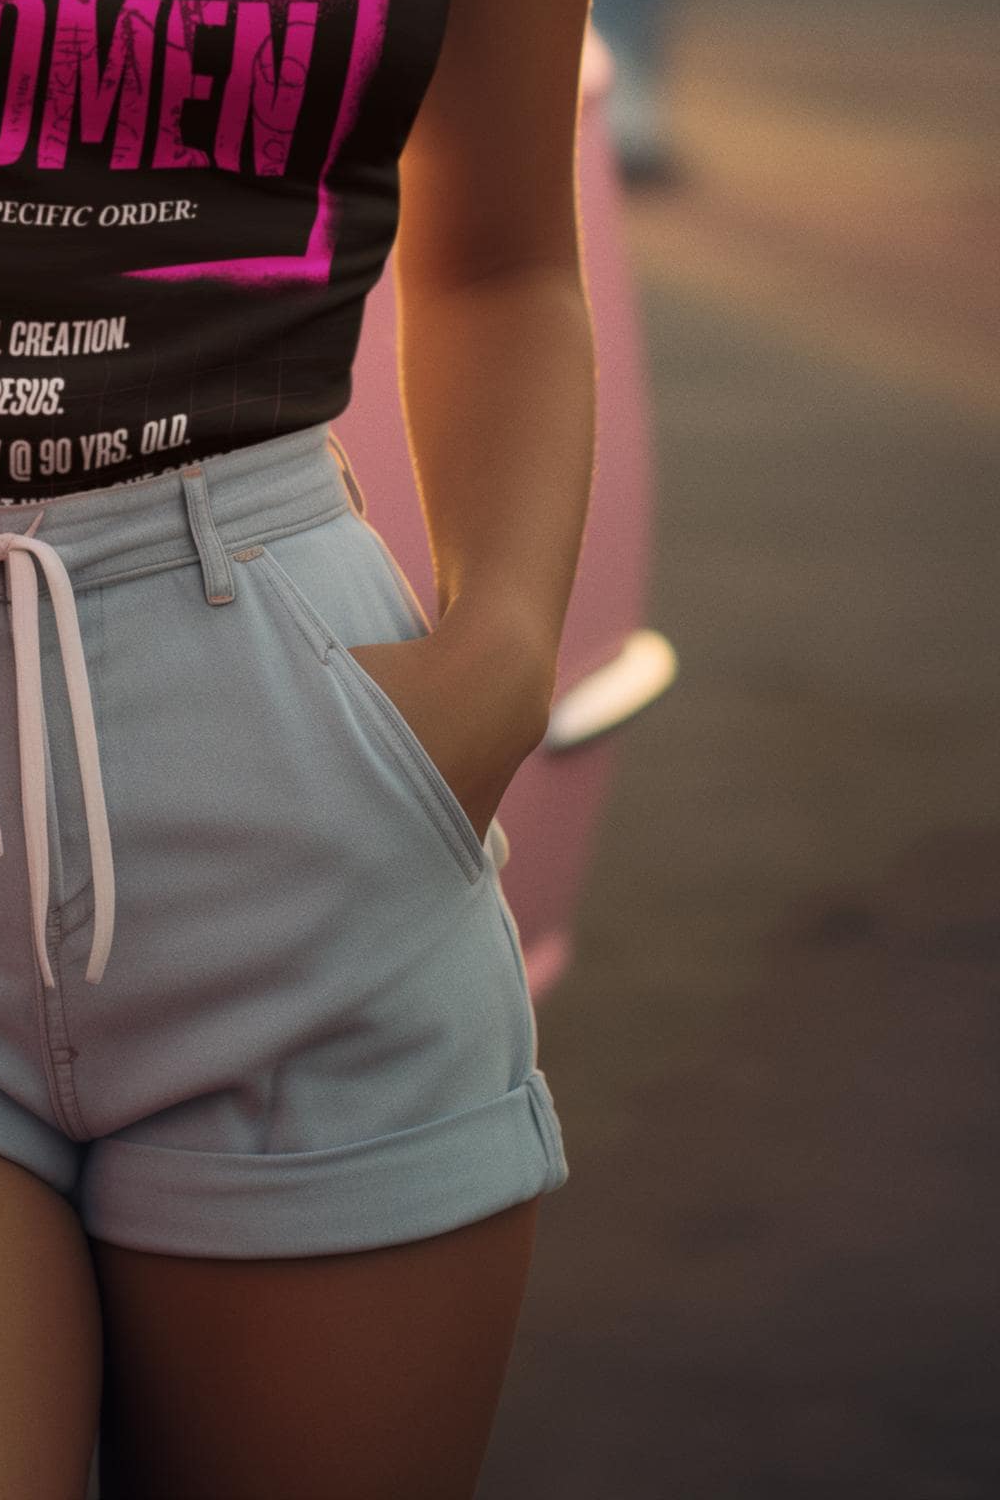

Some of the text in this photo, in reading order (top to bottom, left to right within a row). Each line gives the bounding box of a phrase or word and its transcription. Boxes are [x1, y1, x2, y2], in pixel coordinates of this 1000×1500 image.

[98, 199, 199, 227] ORDER:
[9, 316, 130, 357] CREATION.
[9, 439, 32, 482] @
[39, 437, 72, 475] 90
[80, 428, 132, 471] YRS.
[140, 413, 191, 455] OLD.
